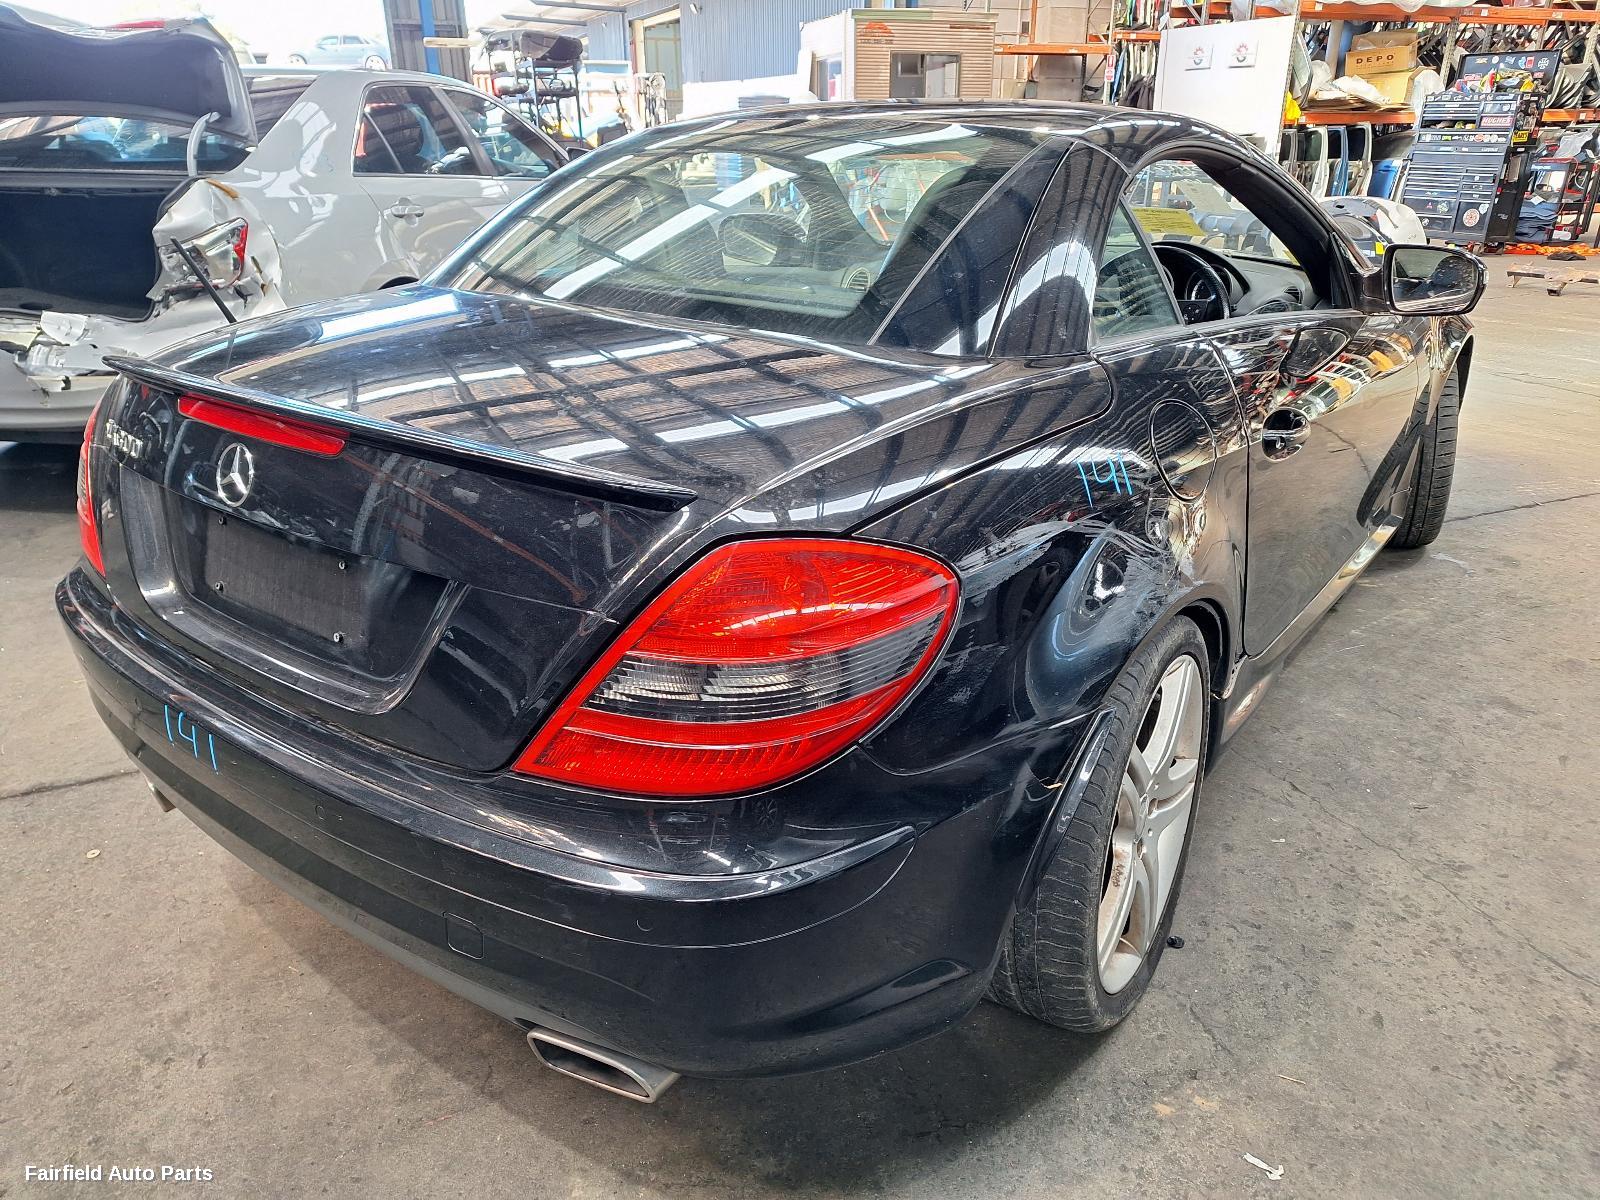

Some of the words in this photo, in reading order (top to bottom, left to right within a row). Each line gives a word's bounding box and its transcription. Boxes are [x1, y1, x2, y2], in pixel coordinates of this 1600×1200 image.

[1356, 54, 1394, 64] DEPO
[1076, 451, 1132, 508] 141
[164, 704, 218, 775] 141
